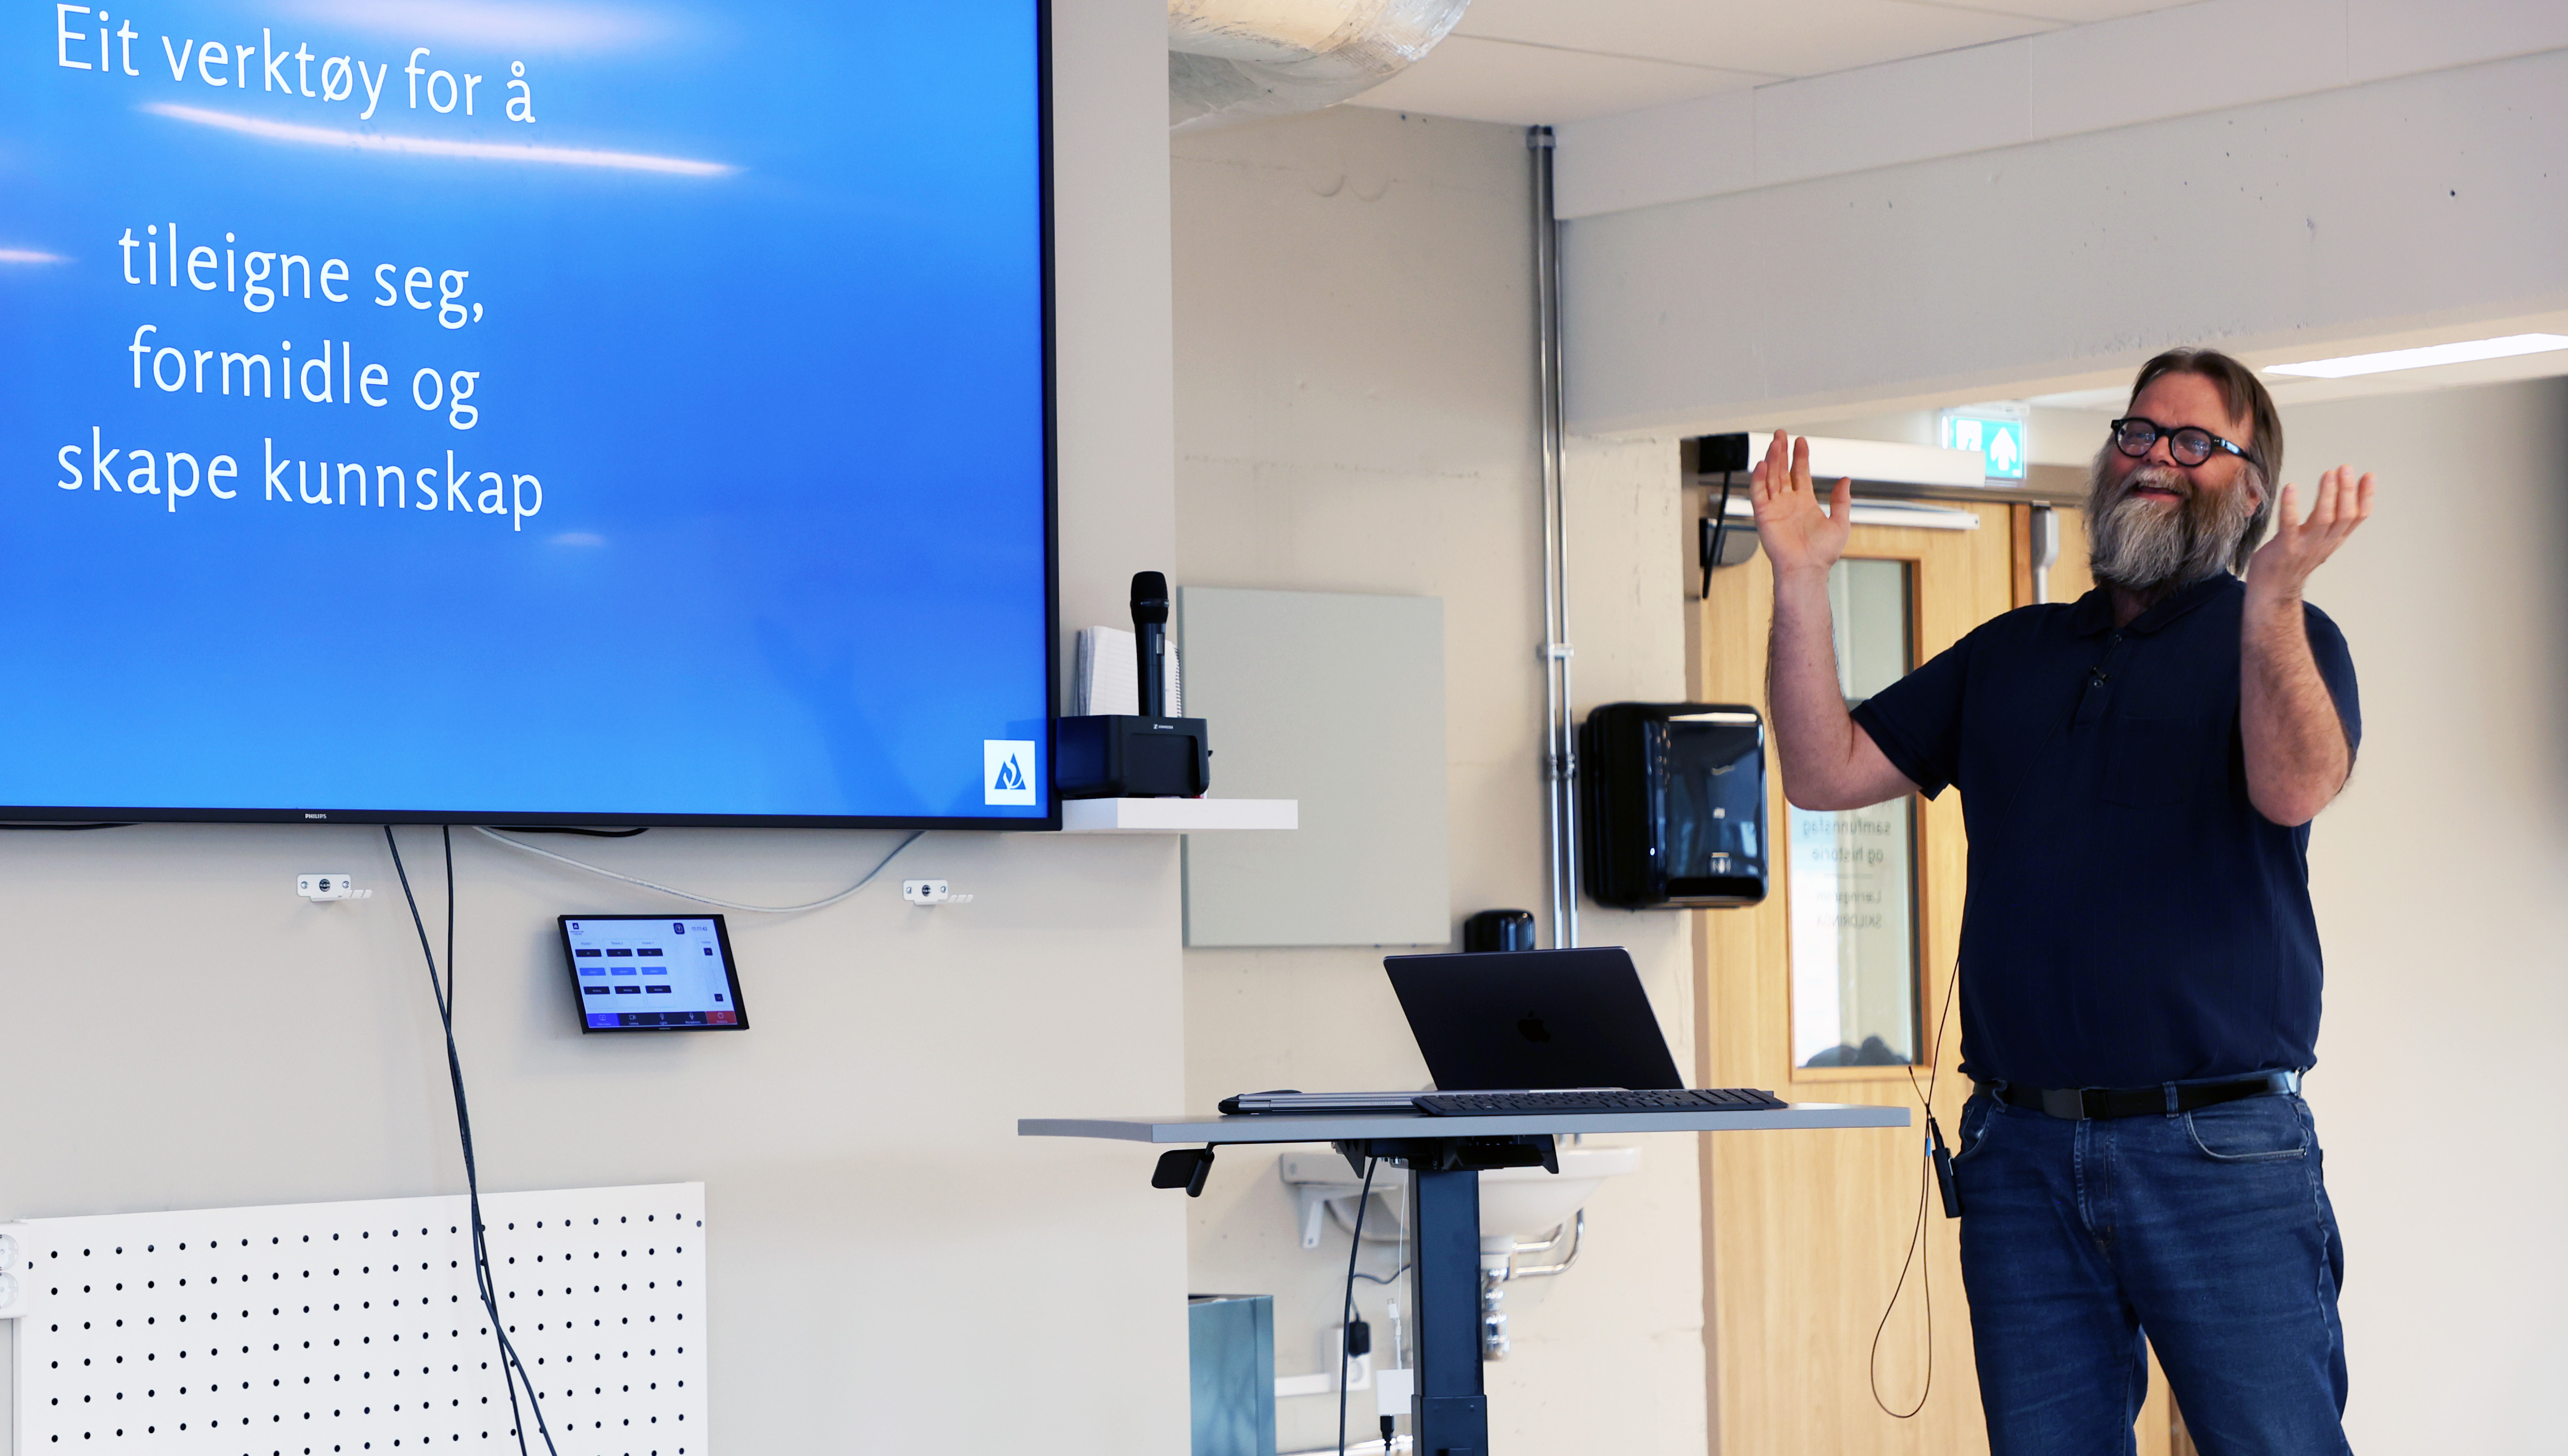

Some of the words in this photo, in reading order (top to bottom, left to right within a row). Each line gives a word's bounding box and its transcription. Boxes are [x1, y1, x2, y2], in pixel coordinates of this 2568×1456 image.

[56, 3, 139, 76] Eit
[161, 27, 388, 120] verktøy
[404, 47, 482, 115] for
[506, 60, 536, 123] å
[118, 222, 349, 312] tileigne
[375, 263, 483, 329] seg,
[128, 325, 388, 407] formidle
[413, 368, 480, 430] og
[58, 426, 237, 512] skape
[265, 437, 542, 532] kunnskap
